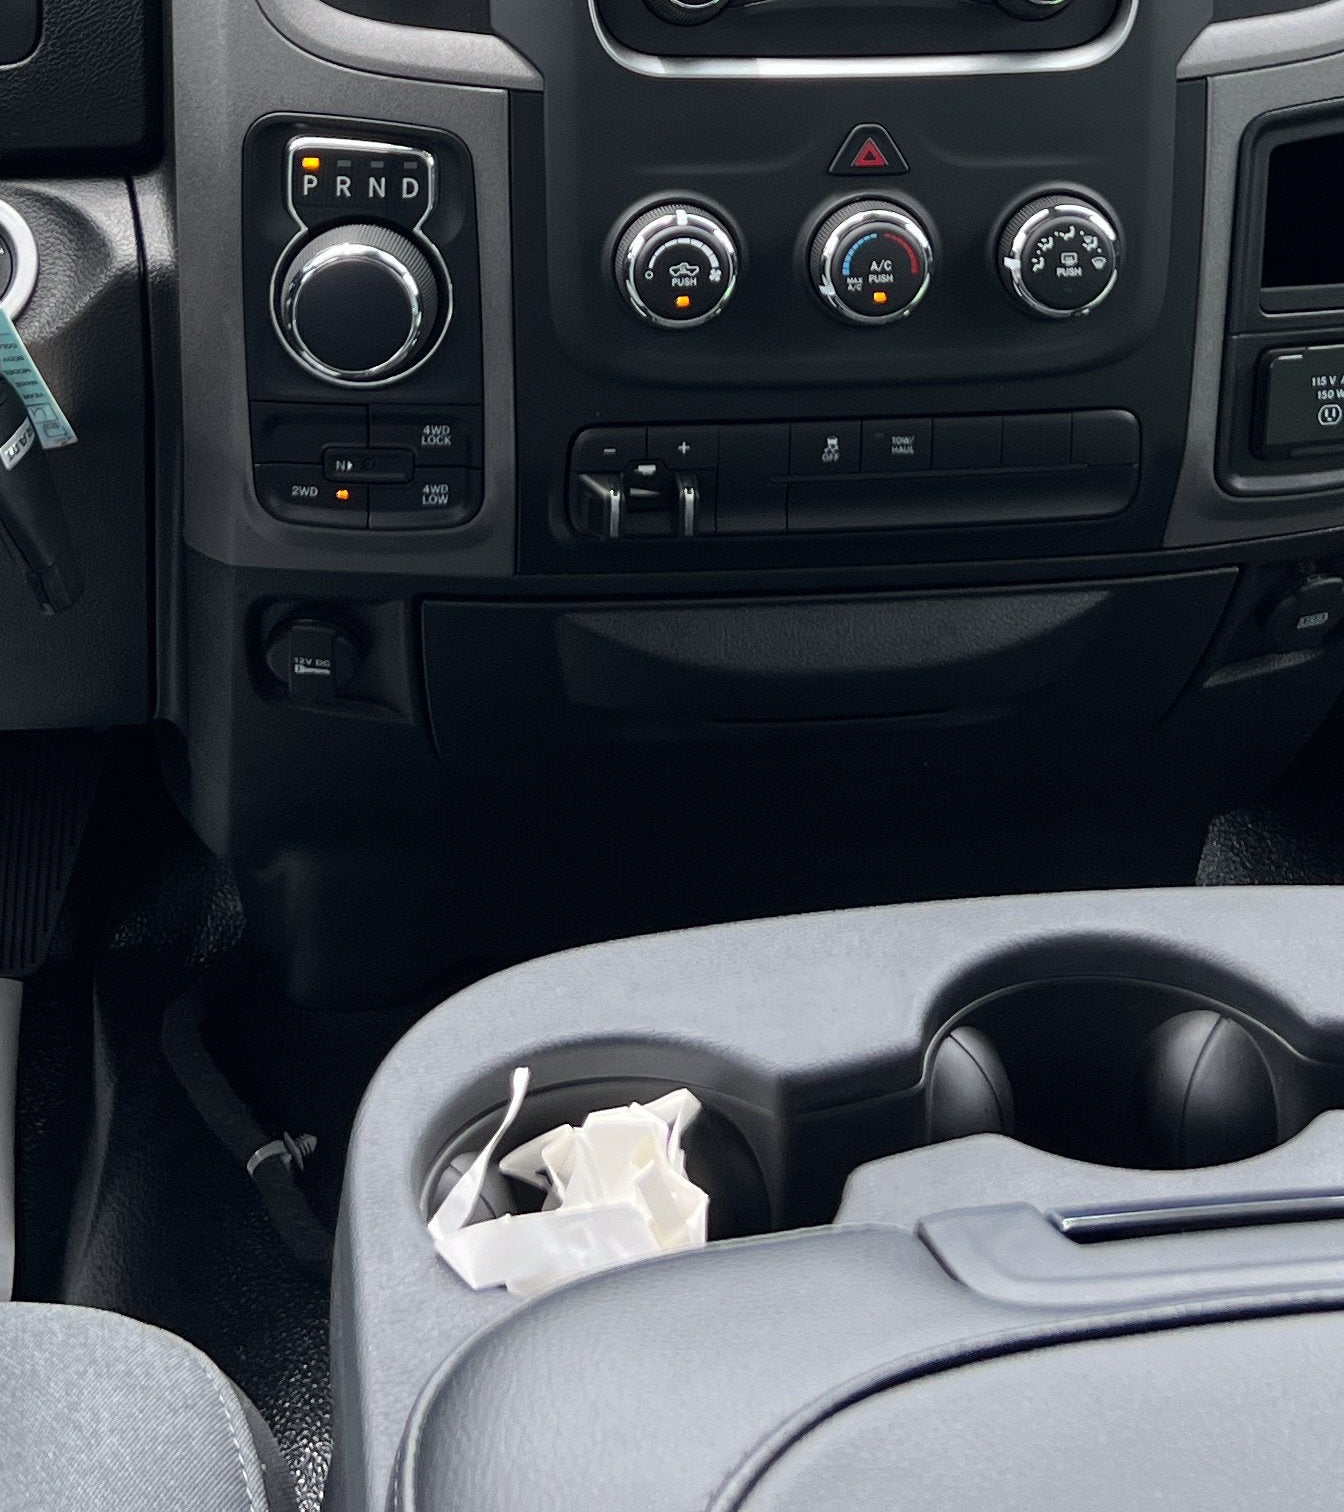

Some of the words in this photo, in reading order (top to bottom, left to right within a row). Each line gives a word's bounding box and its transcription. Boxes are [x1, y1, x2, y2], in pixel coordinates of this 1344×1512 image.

[303, 175, 319, 195] P
[336, 177, 353, 197] R
[369, 177, 386, 198] N
[402, 177, 420, 199] D
[869, 259, 892, 272] A/C
[1056, 266, 1082, 277] PUSH
[670, 276, 697, 287] PUSH
[867, 273, 894, 284] PUSH
[1311, 374, 1328, 386] 115
[1329, 374, 1337, 386] V
[1317, 389, 1334, 400] 150
[422, 424, 451, 436] 4WD
[421, 436, 452, 446] LOCK
[336, 459, 346, 471] N
[291, 485, 319, 497] 2WD
[422, 483, 449, 494] 4WD
[422, 494, 449, 505] LOW
